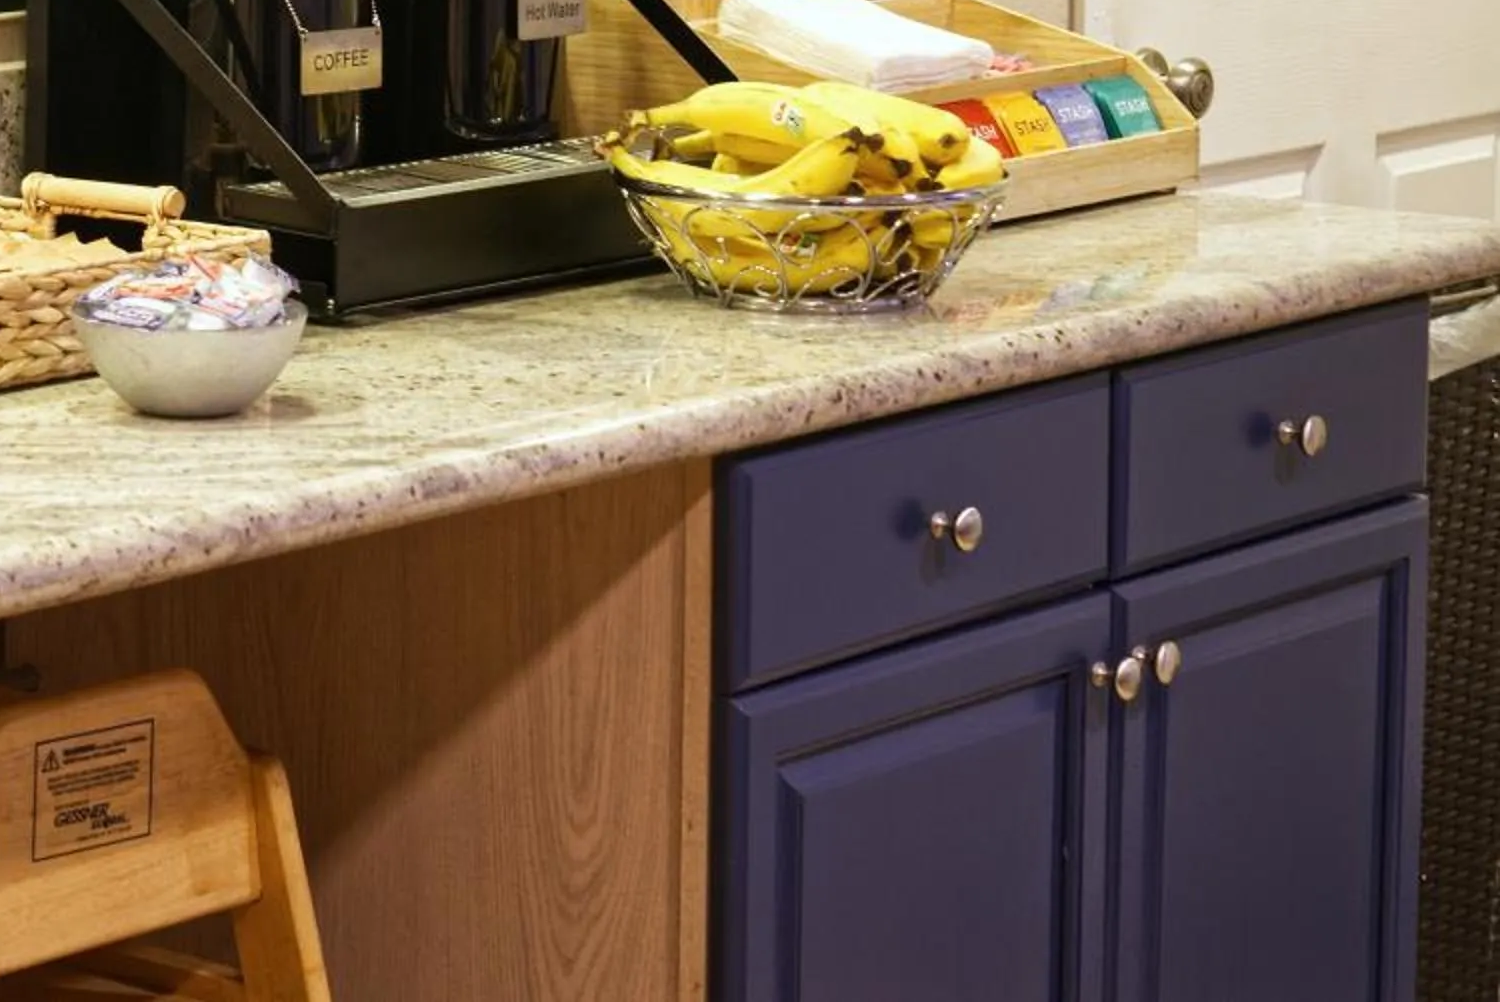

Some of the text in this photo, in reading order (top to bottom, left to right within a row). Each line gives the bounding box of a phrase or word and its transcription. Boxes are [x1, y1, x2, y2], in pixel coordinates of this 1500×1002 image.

[525, 0, 581, 22] Hot Water
[313, 48, 369, 72] COFFEE
[1058, 105, 1093, 123] STASH
[1014, 119, 1049, 136] STASH
